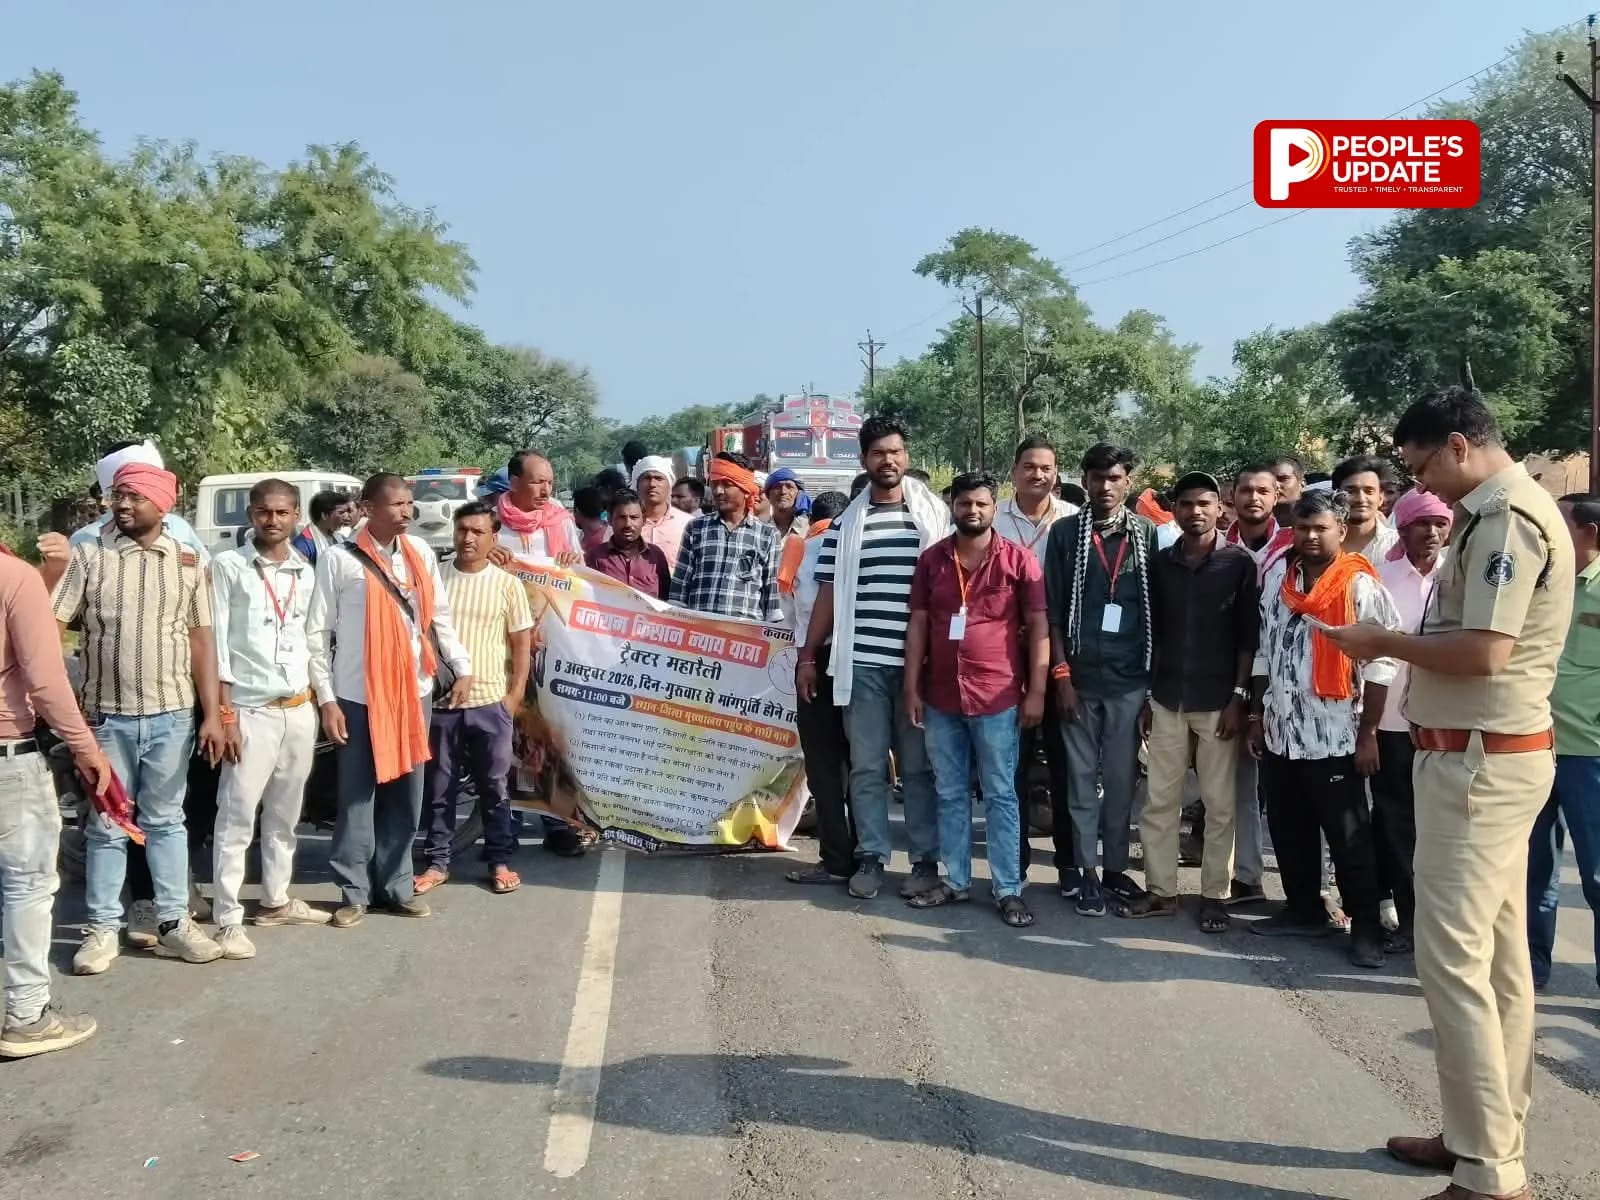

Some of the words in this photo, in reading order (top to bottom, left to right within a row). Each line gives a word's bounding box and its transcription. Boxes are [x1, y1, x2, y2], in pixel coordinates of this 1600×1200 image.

[555, 659, 562, 673] 8
[705, 687, 716, 705] से
[763, 701, 785, 720] होने
[667, 656, 722, 681] महारैली
